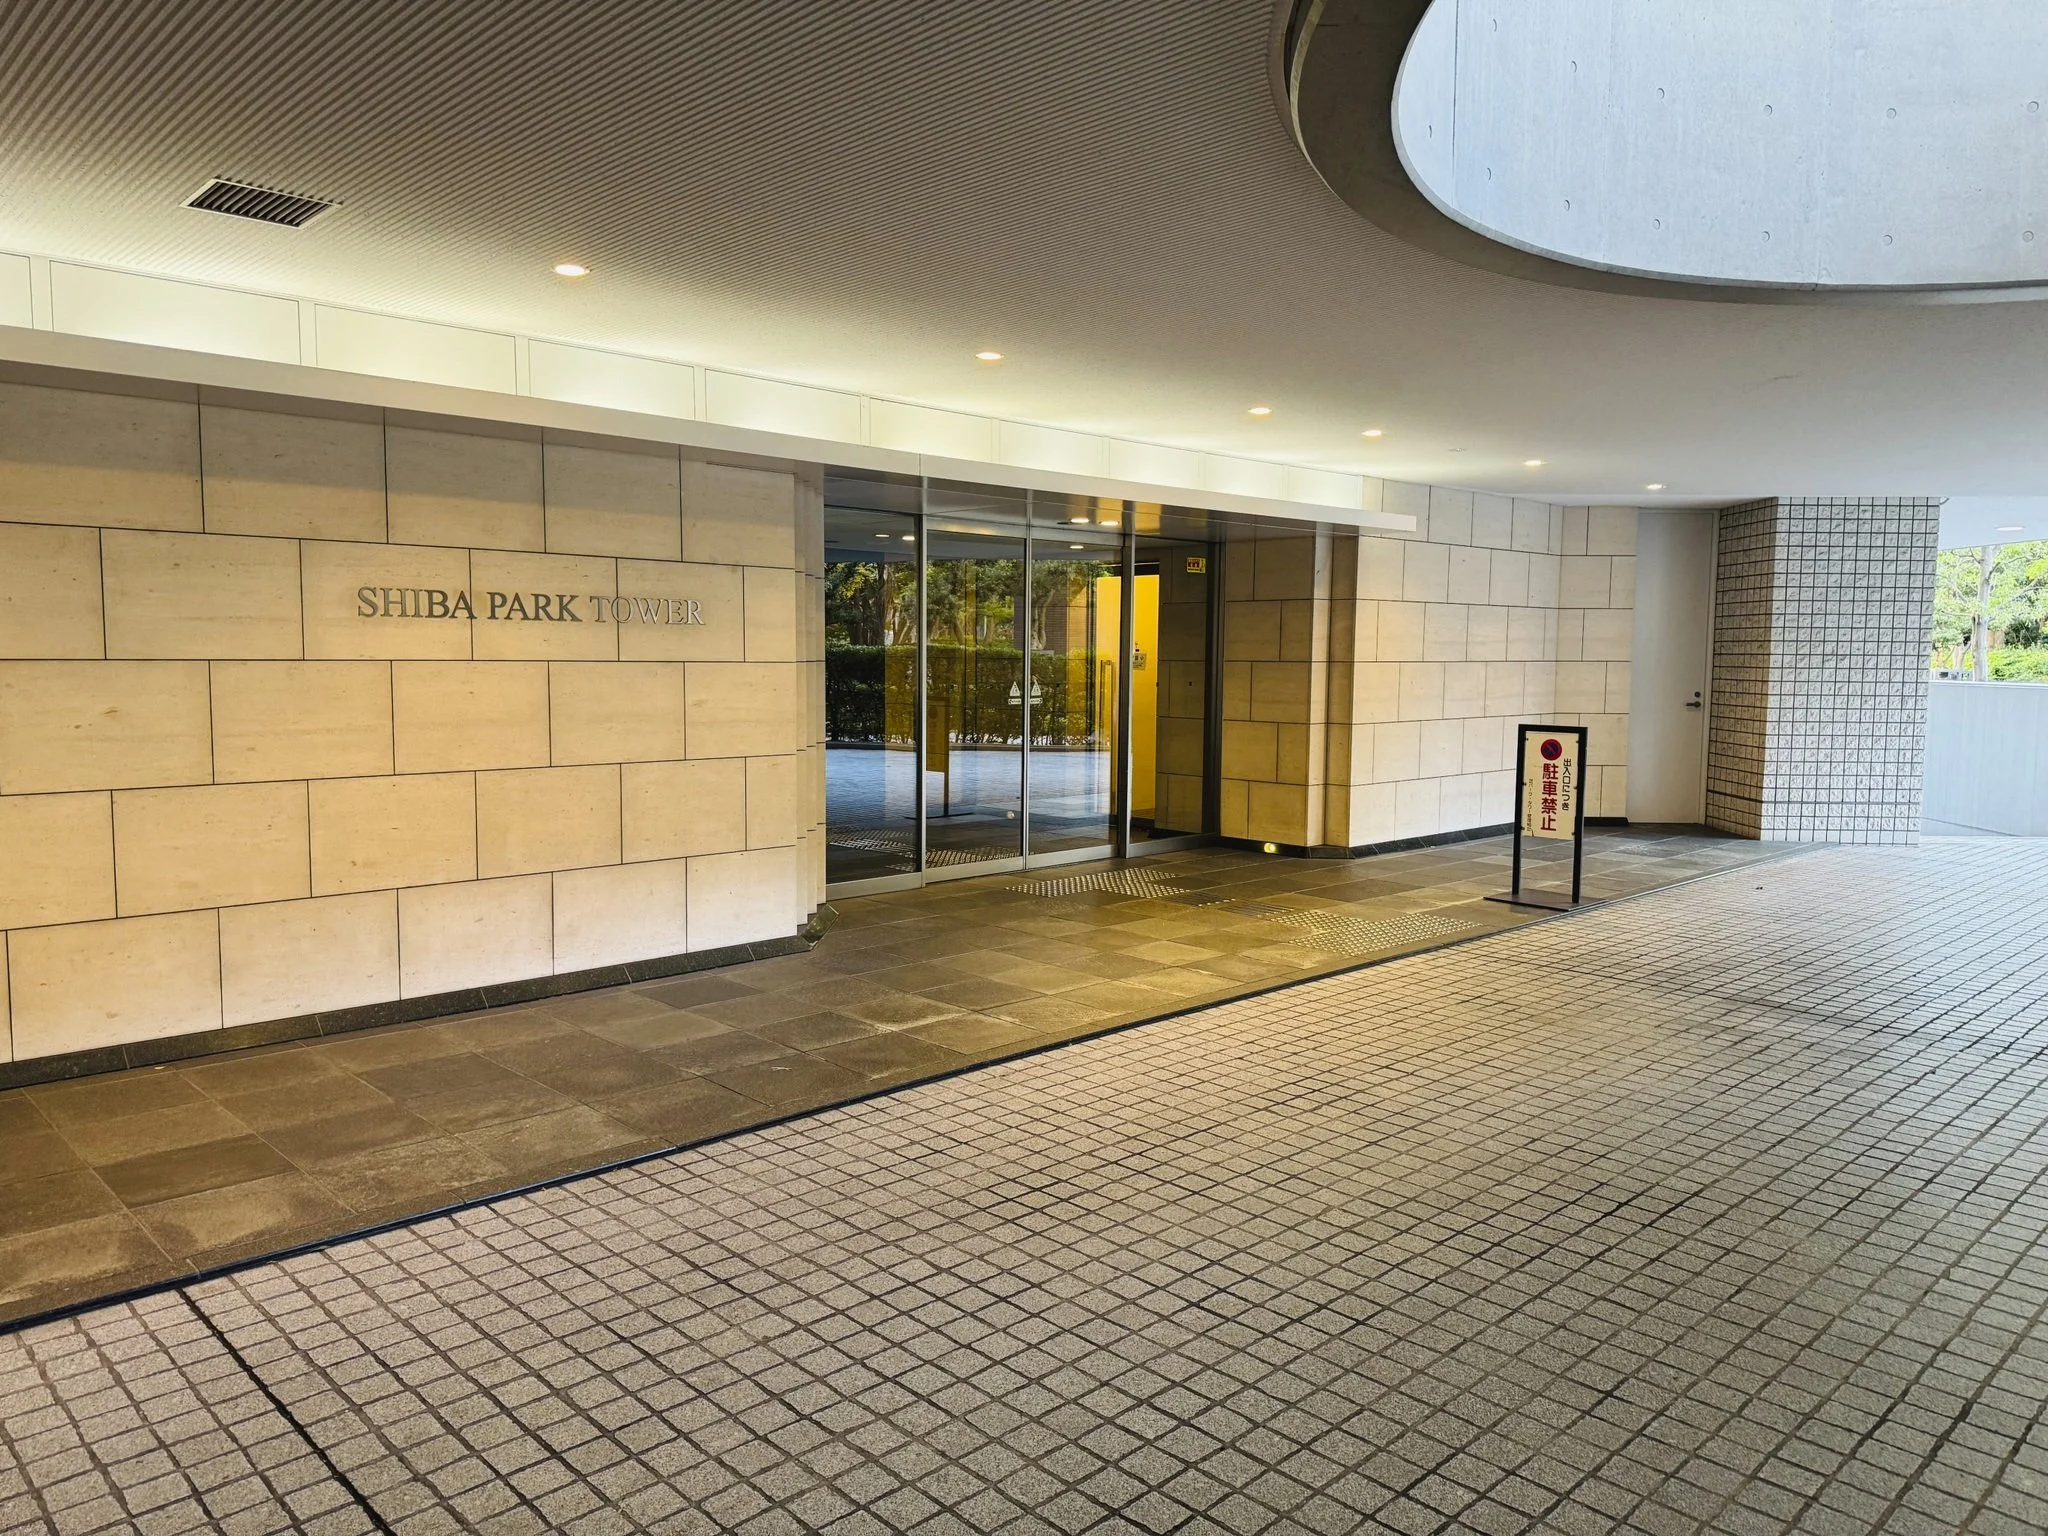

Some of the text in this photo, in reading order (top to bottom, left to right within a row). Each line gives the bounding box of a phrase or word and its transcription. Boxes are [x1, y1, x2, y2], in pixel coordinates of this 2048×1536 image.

[357, 586, 705, 625] SHIBA PARK TOWER
[1540, 763, 1559, 831] 駐車禁止
[1561, 757, 1571, 811] 出入口につき
